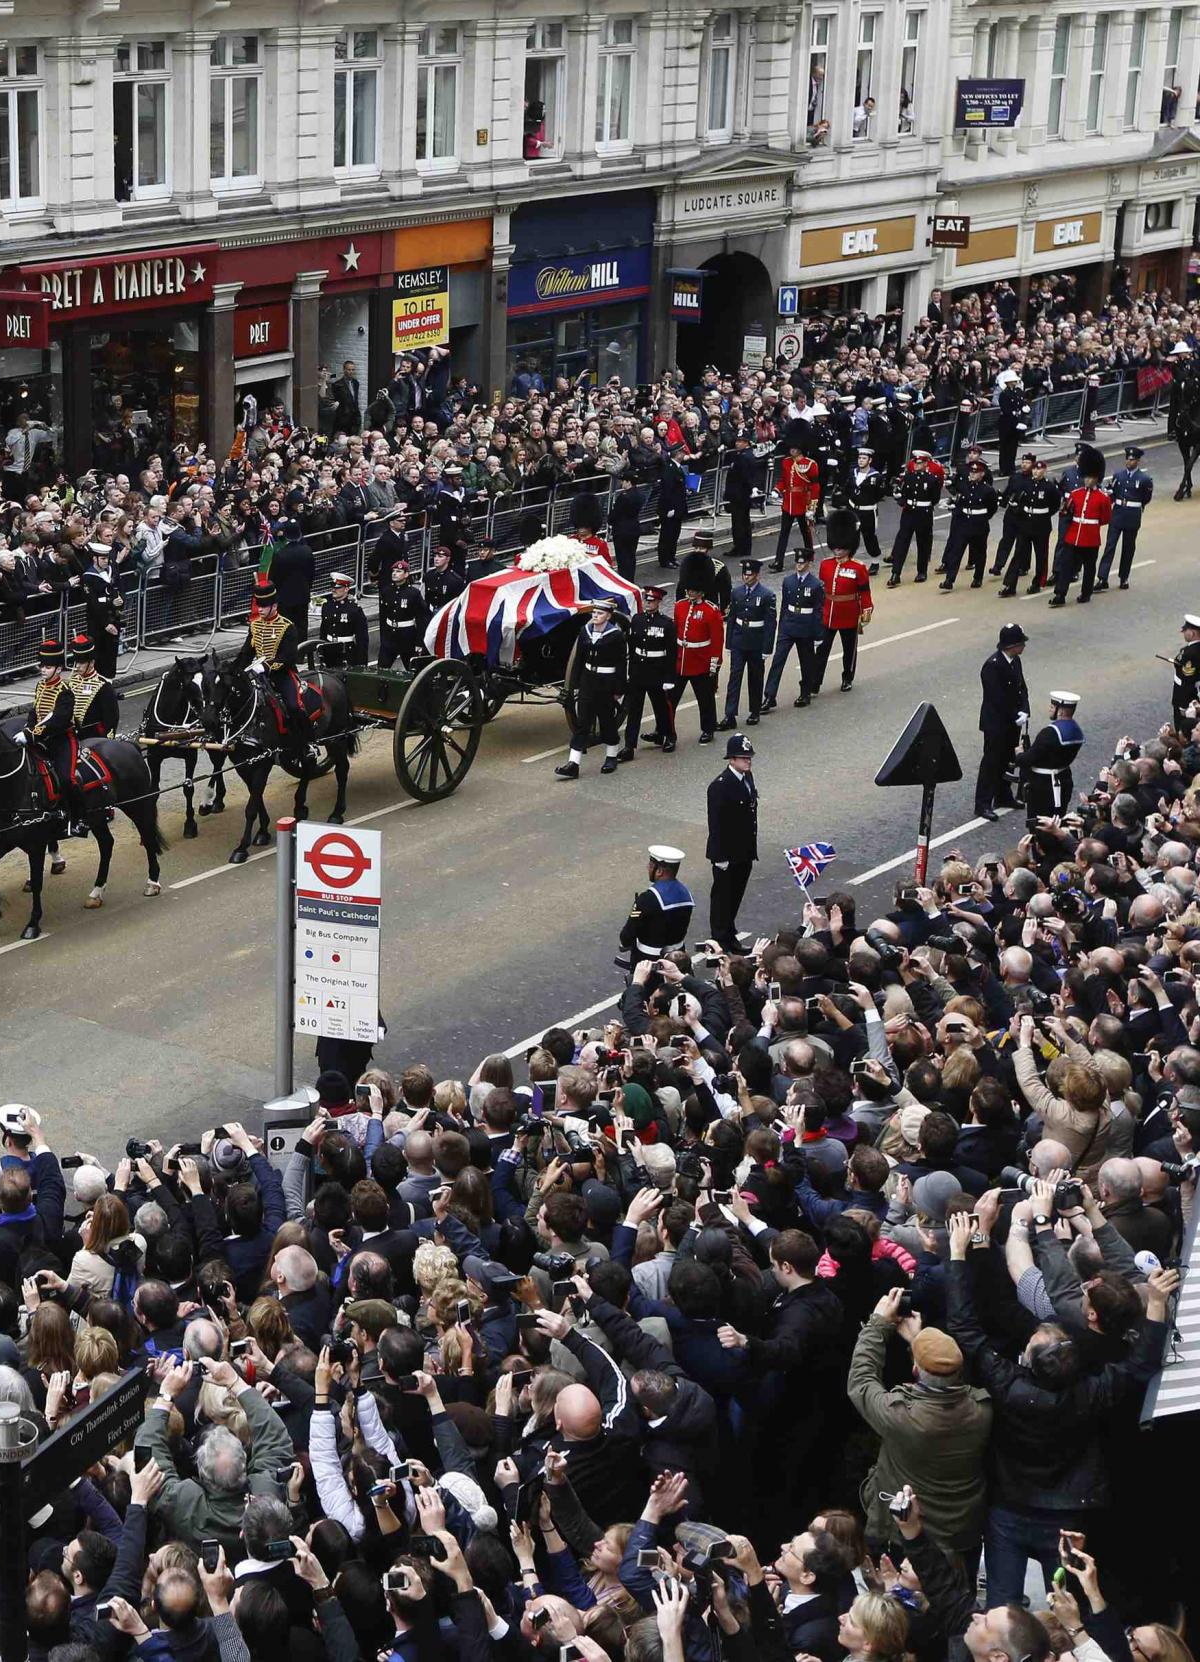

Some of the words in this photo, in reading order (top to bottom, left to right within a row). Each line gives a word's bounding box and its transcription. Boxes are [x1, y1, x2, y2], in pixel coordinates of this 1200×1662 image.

[936, 219, 965, 232] EAT.
[1053, 220, 1084, 245] EAT.
[841, 228, 879, 256] EAT.
[93, 267, 105, 304] A
[114, 257, 186, 301] MANGER
[398, 271, 441, 289] KEMSLEY
[536, 264, 592, 300] William
[590, 261, 620, 289] HILL
[404, 302, 417, 315] TO
[673, 292, 699, 308] HILL
[6, 314, 32, 339] PRET
[397, 318, 420, 331] UNDER
[420, 313, 441, 326] OFFER
[250, 321, 270, 345] PRET
[299, 904, 318, 914] Saint
[318, 907, 339, 917] Paul's
[341, 911, 378, 921] Cathedral
[305, 928, 316, 938] Big
[318, 930, 331, 939] Bus
[333, 932, 369, 944] Company
[305, 974, 319, 982] The
[320, 976, 349, 986] Original
[351, 980, 368, 988] Tour
[306, 996, 317, 1005] T1
[334, 1000, 346, 1009] T2
[300, 1017, 317, 1028] 810
[70, 1429, 84, 1446] City
[85, 1400, 118, 1433] Thameslink
[119, 1384, 140, 1407] Station
[107, 1425, 122, 1444] Fleet
[123, 1410, 140, 1431] Street
